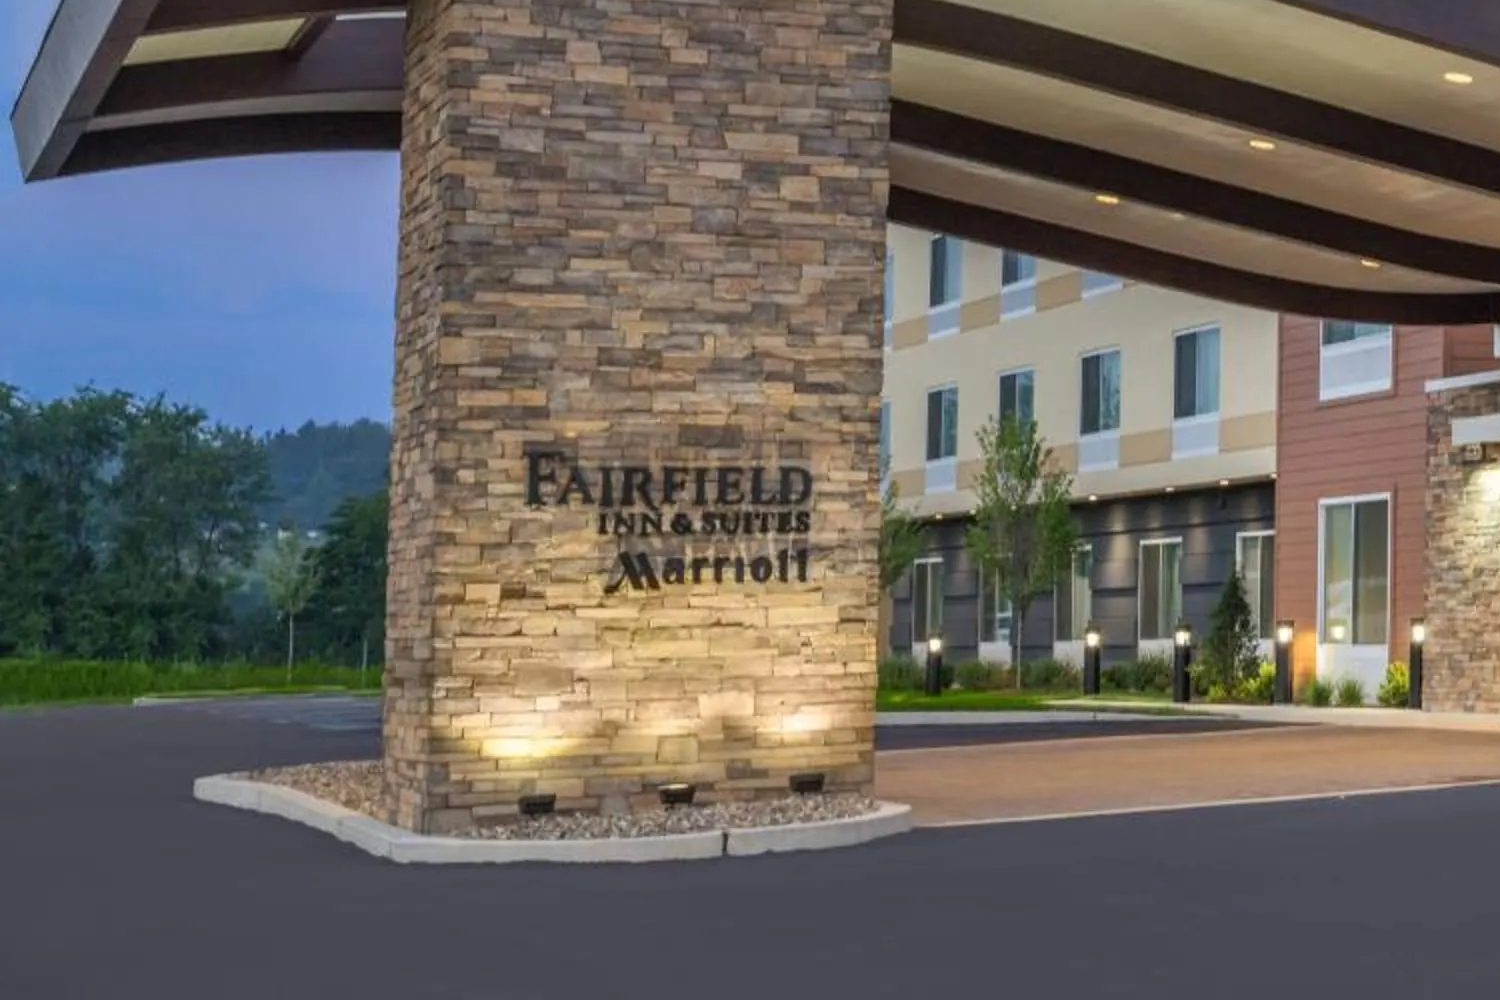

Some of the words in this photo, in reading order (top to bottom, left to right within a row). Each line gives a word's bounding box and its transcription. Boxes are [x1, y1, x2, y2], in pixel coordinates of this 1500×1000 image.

[523, 450, 812, 508] FAIRFIELD
[702, 511, 811, 534] SUITES
[604, 548, 810, 595] Marriott
